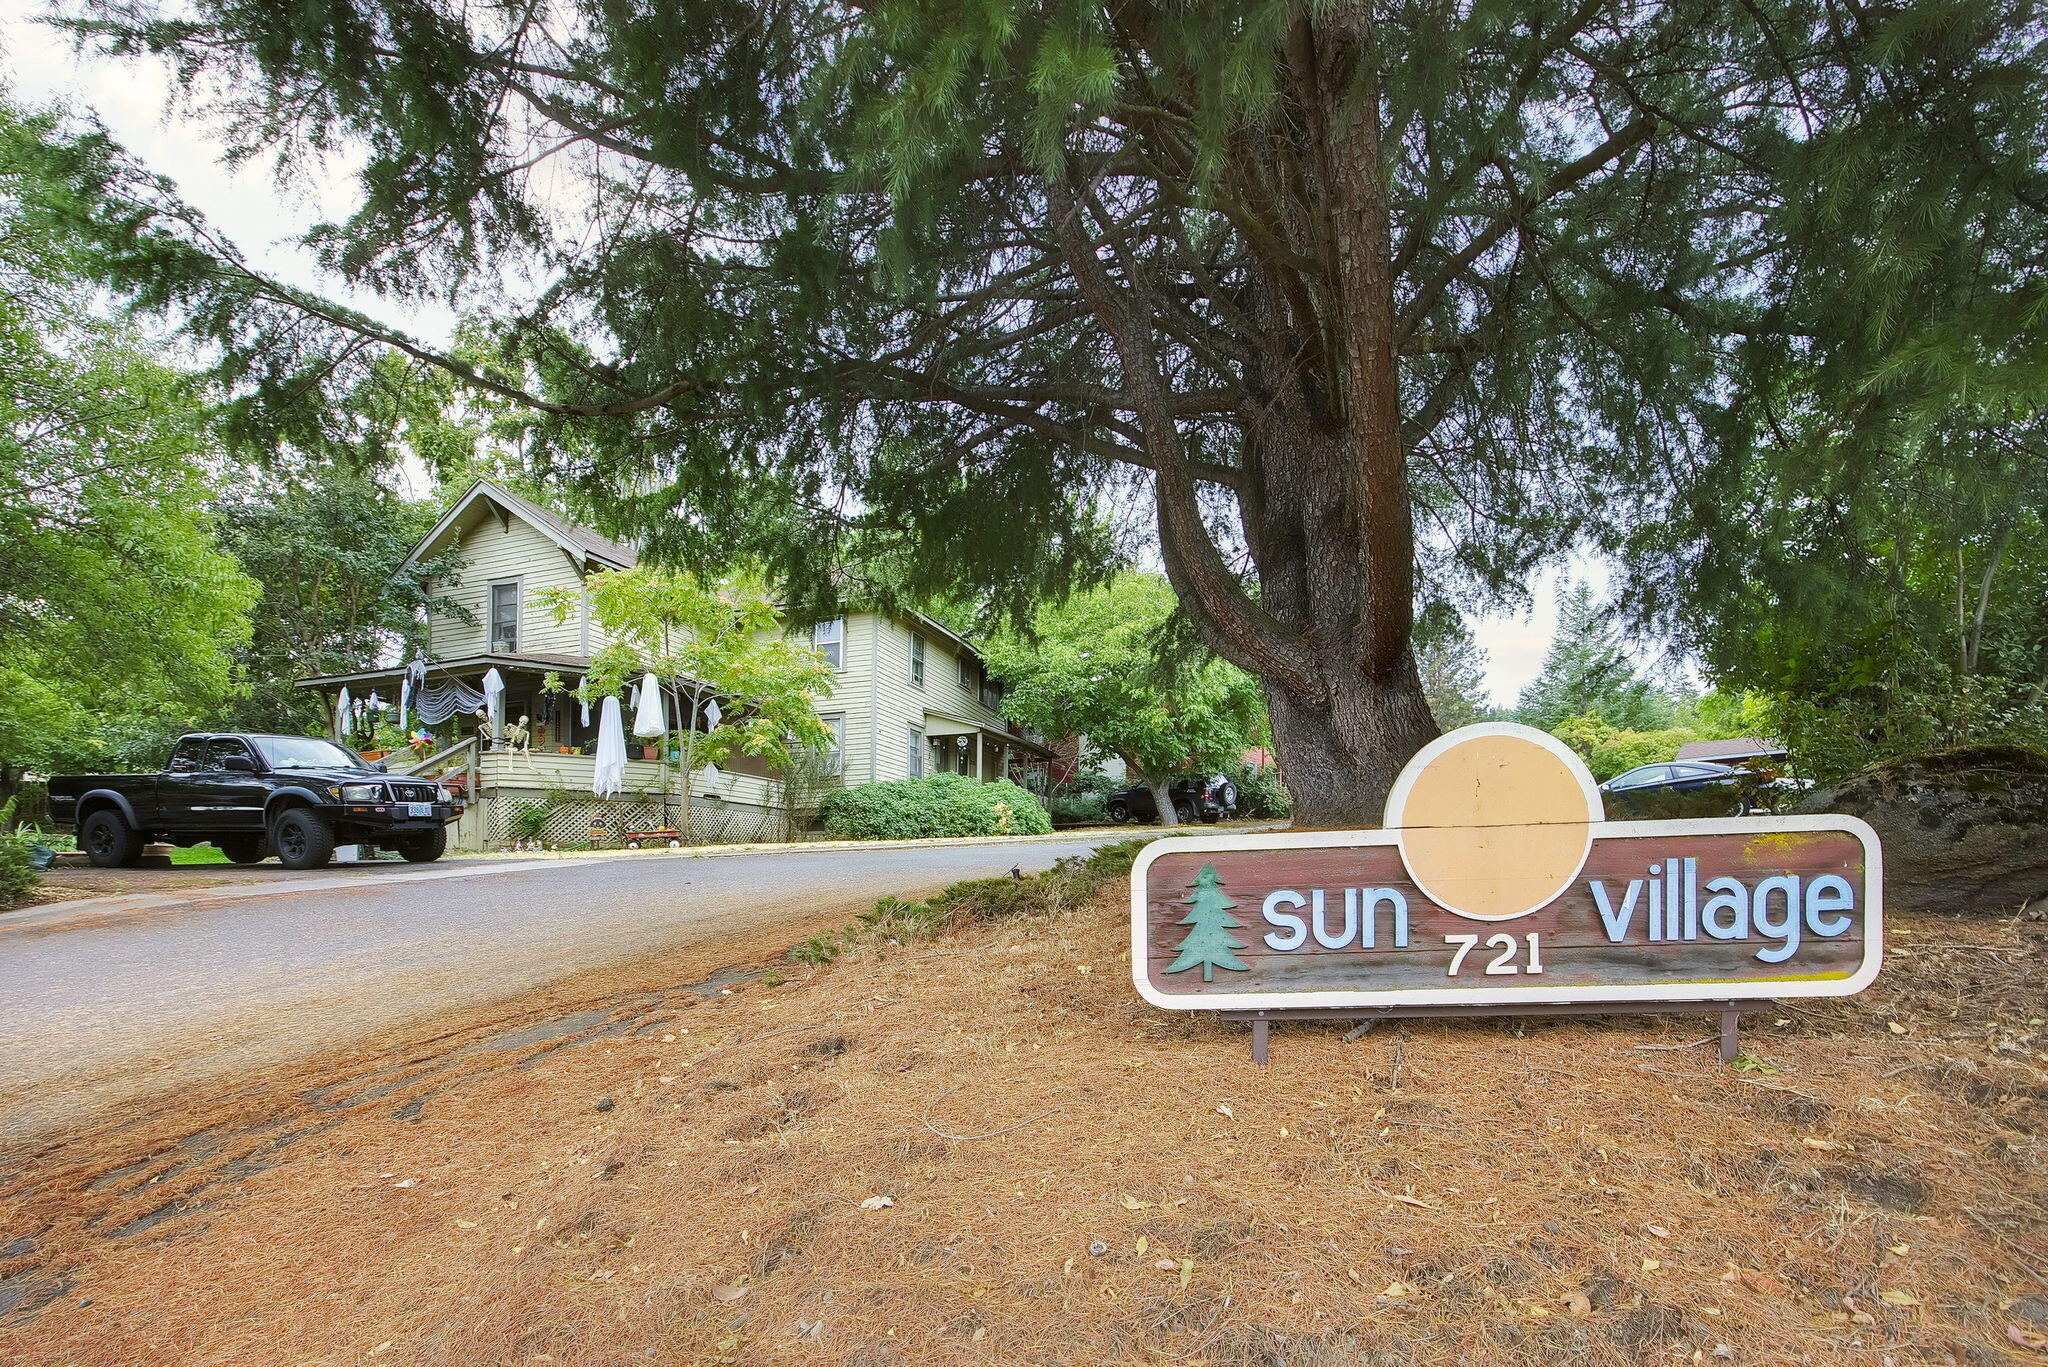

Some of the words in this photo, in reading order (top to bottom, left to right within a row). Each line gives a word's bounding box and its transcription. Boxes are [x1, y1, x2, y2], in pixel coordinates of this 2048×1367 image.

[1262, 887, 1409, 951] sun
[1588, 857, 1854, 963] village
[1444, 932, 1543, 976] 721
